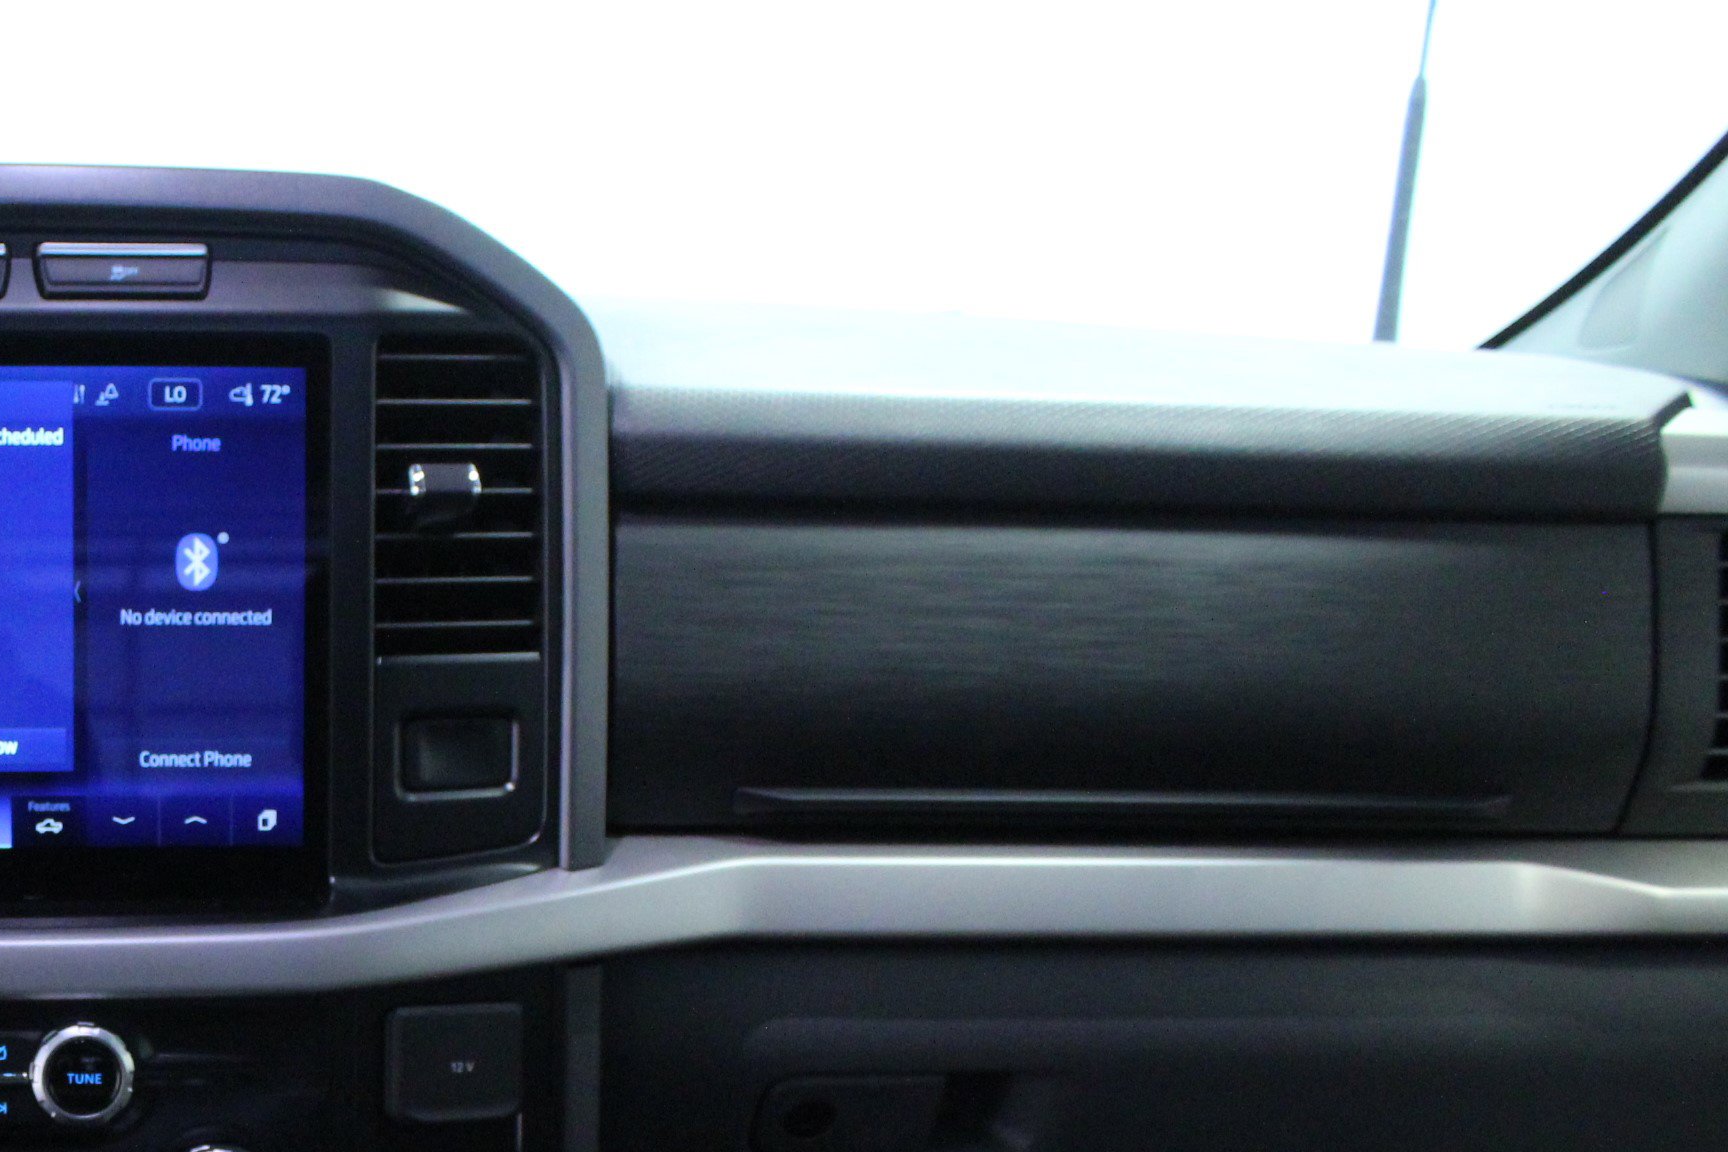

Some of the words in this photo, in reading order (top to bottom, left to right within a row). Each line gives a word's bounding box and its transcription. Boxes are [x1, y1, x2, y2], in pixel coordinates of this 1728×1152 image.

[163, 385, 187, 404] LO
[172, 434, 222, 452] Phone
[119, 608, 142, 626] No
[144, 608, 193, 626] device
[194, 608, 272, 626] connected
[139, 750, 202, 768] Connect
[203, 750, 253, 768] Phone
[28, 800, 71, 812] Features
[67, 1072, 103, 1085] TUNE
